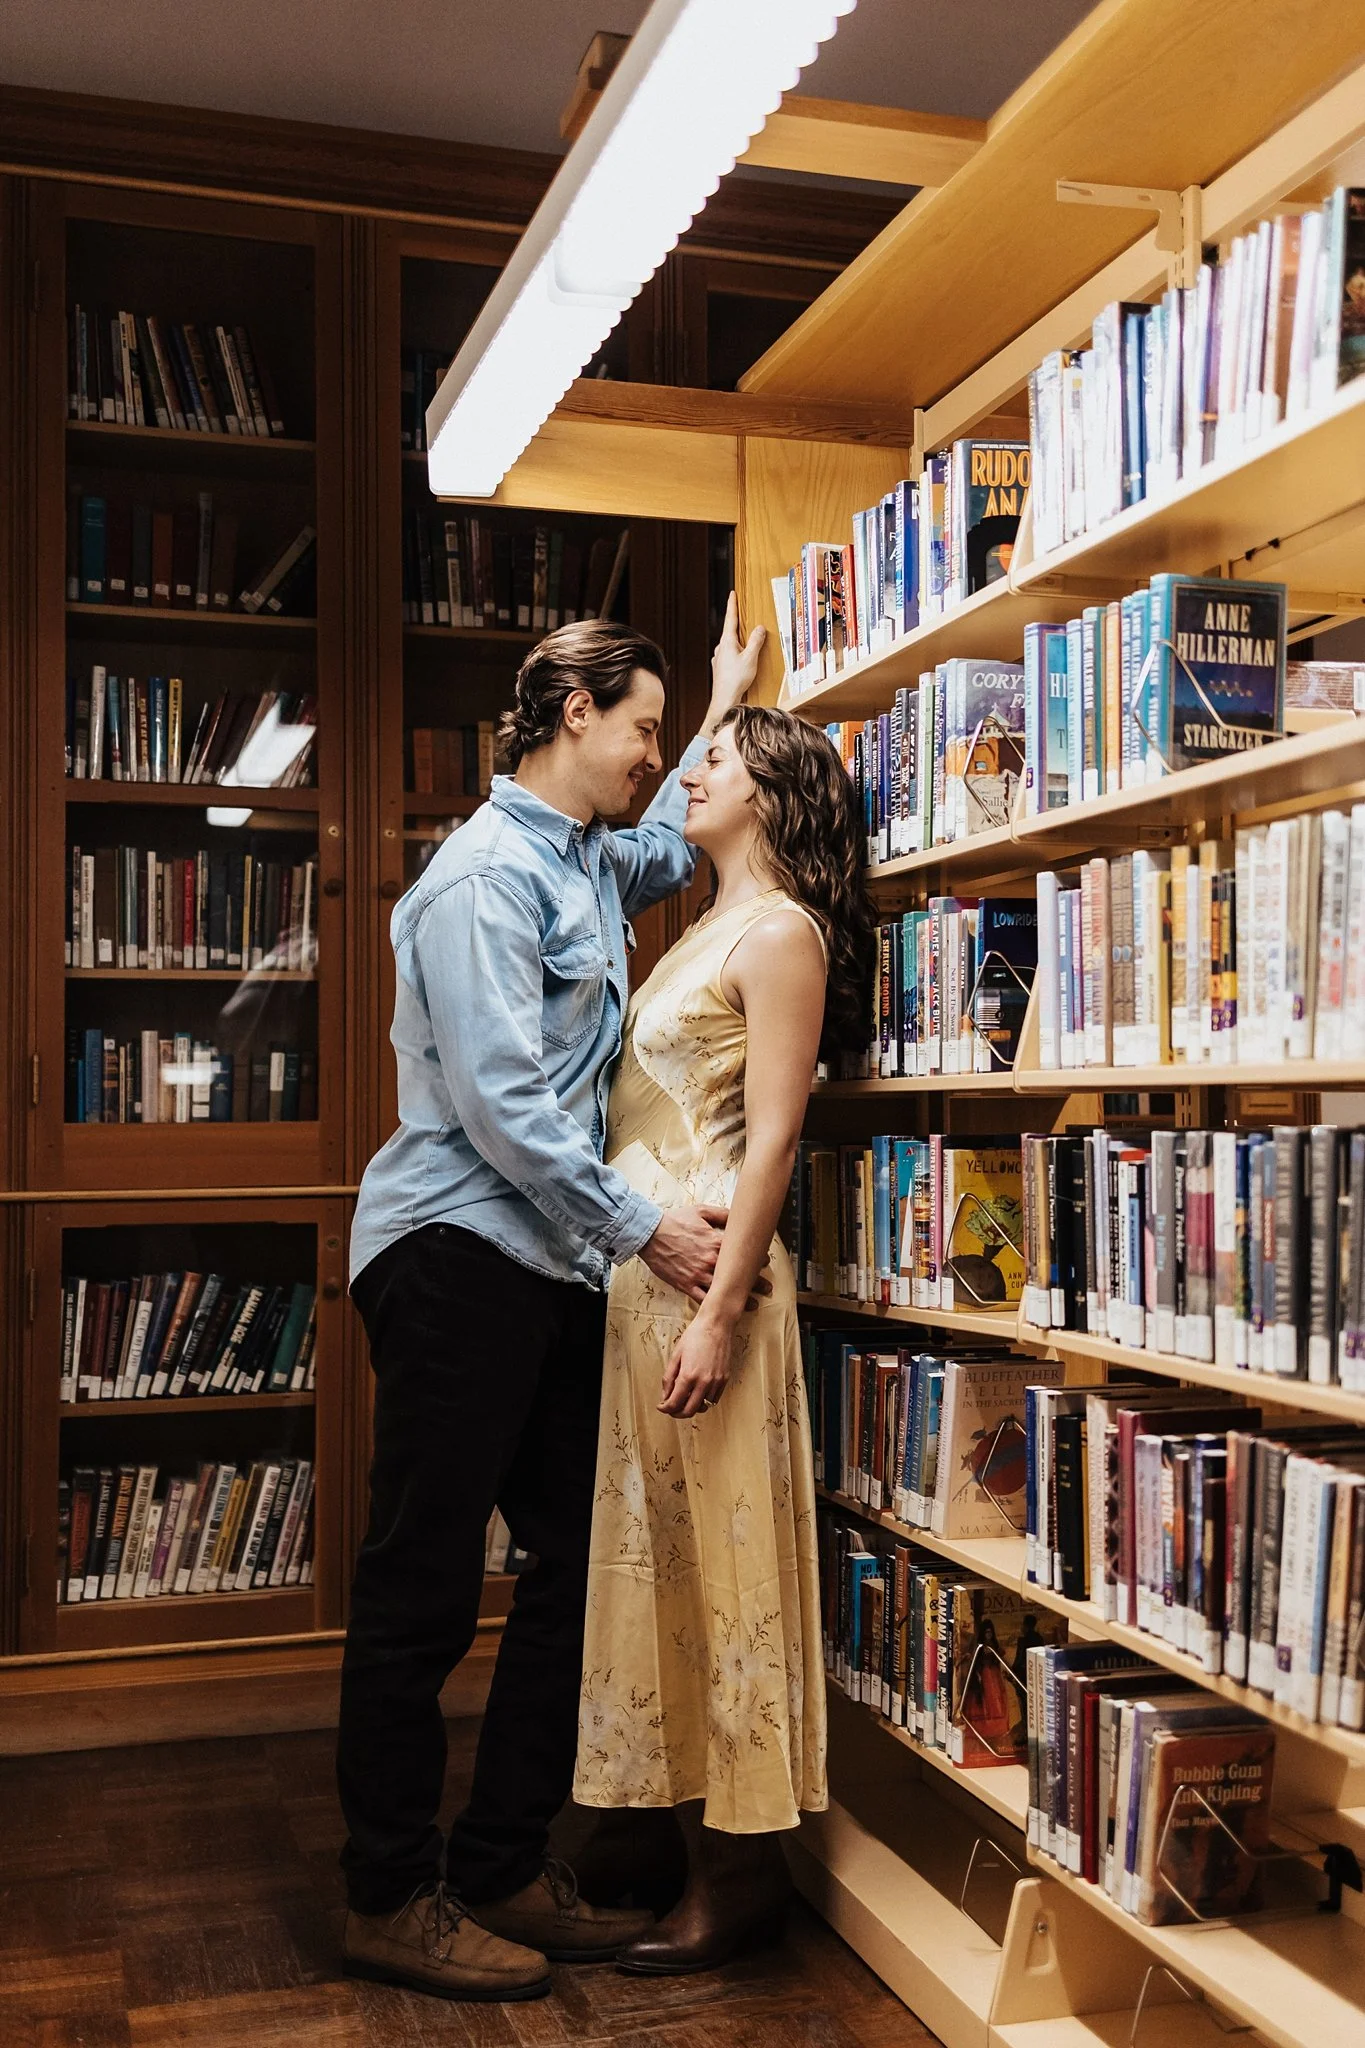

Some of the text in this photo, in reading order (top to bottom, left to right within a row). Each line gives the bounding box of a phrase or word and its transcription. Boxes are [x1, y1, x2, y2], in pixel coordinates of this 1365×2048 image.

[972, 450, 1031, 487] RUDO
[1204, 602, 1250, 634] ANNE
[1177, 632, 1276, 668] HILLERMAN
[949, 985, 956, 995] By
[238, 1288, 264, 1324] BANANA
[964, 1369, 1060, 1384] BLUEFEATHER
[962, 1400, 973, 1409] IN
[975, 1399, 991, 1408] THE
[120, 1476, 134, 1495] TONY
[141, 1472, 153, 1488] TONY
[135, 1488, 150, 1521] HILLERMAN
[112, 1496, 130, 1538] HILLERMAN
[959, 1525, 992, 1535] MAX
[860, 1563, 872, 1573] NO
[938, 1589, 947, 1640] BANANA
[1174, 1763, 1262, 1782] Bubble Gum
[1207, 1784, 1262, 1806] Kipling
